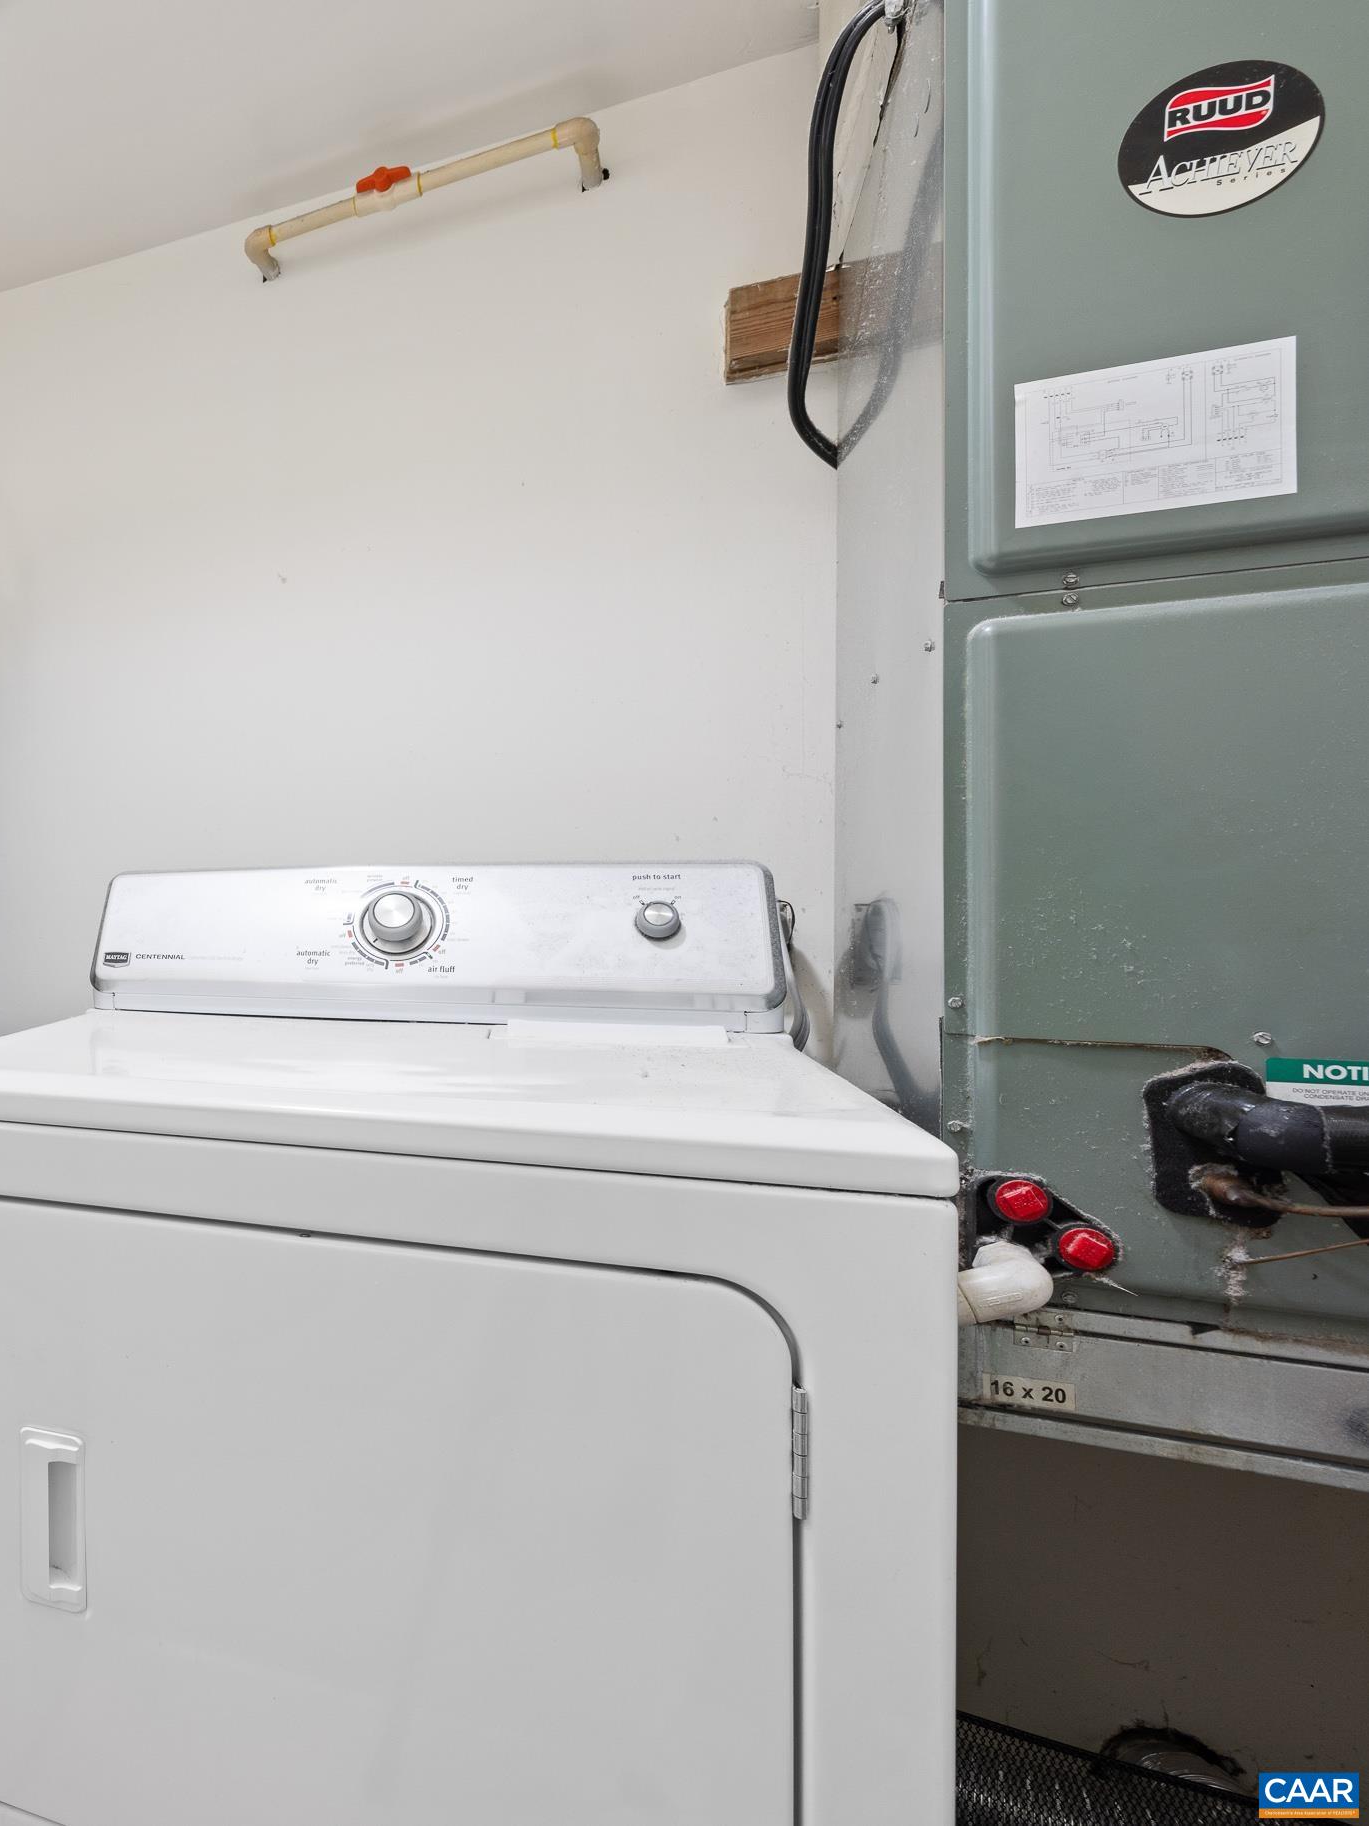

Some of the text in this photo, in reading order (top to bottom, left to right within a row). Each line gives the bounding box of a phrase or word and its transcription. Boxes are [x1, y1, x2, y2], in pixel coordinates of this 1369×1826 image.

[1167, 89, 1271, 129] RUUD
[1216, 167, 1286, 186] Series
[314, 884, 326, 892] dry
[307, 958, 319, 966] dry
[439, 965, 455, 973] fluff
[1302, 1064, 1369, 1081] NOTI
[990, 1380, 1067, 1404] 16 x 20
